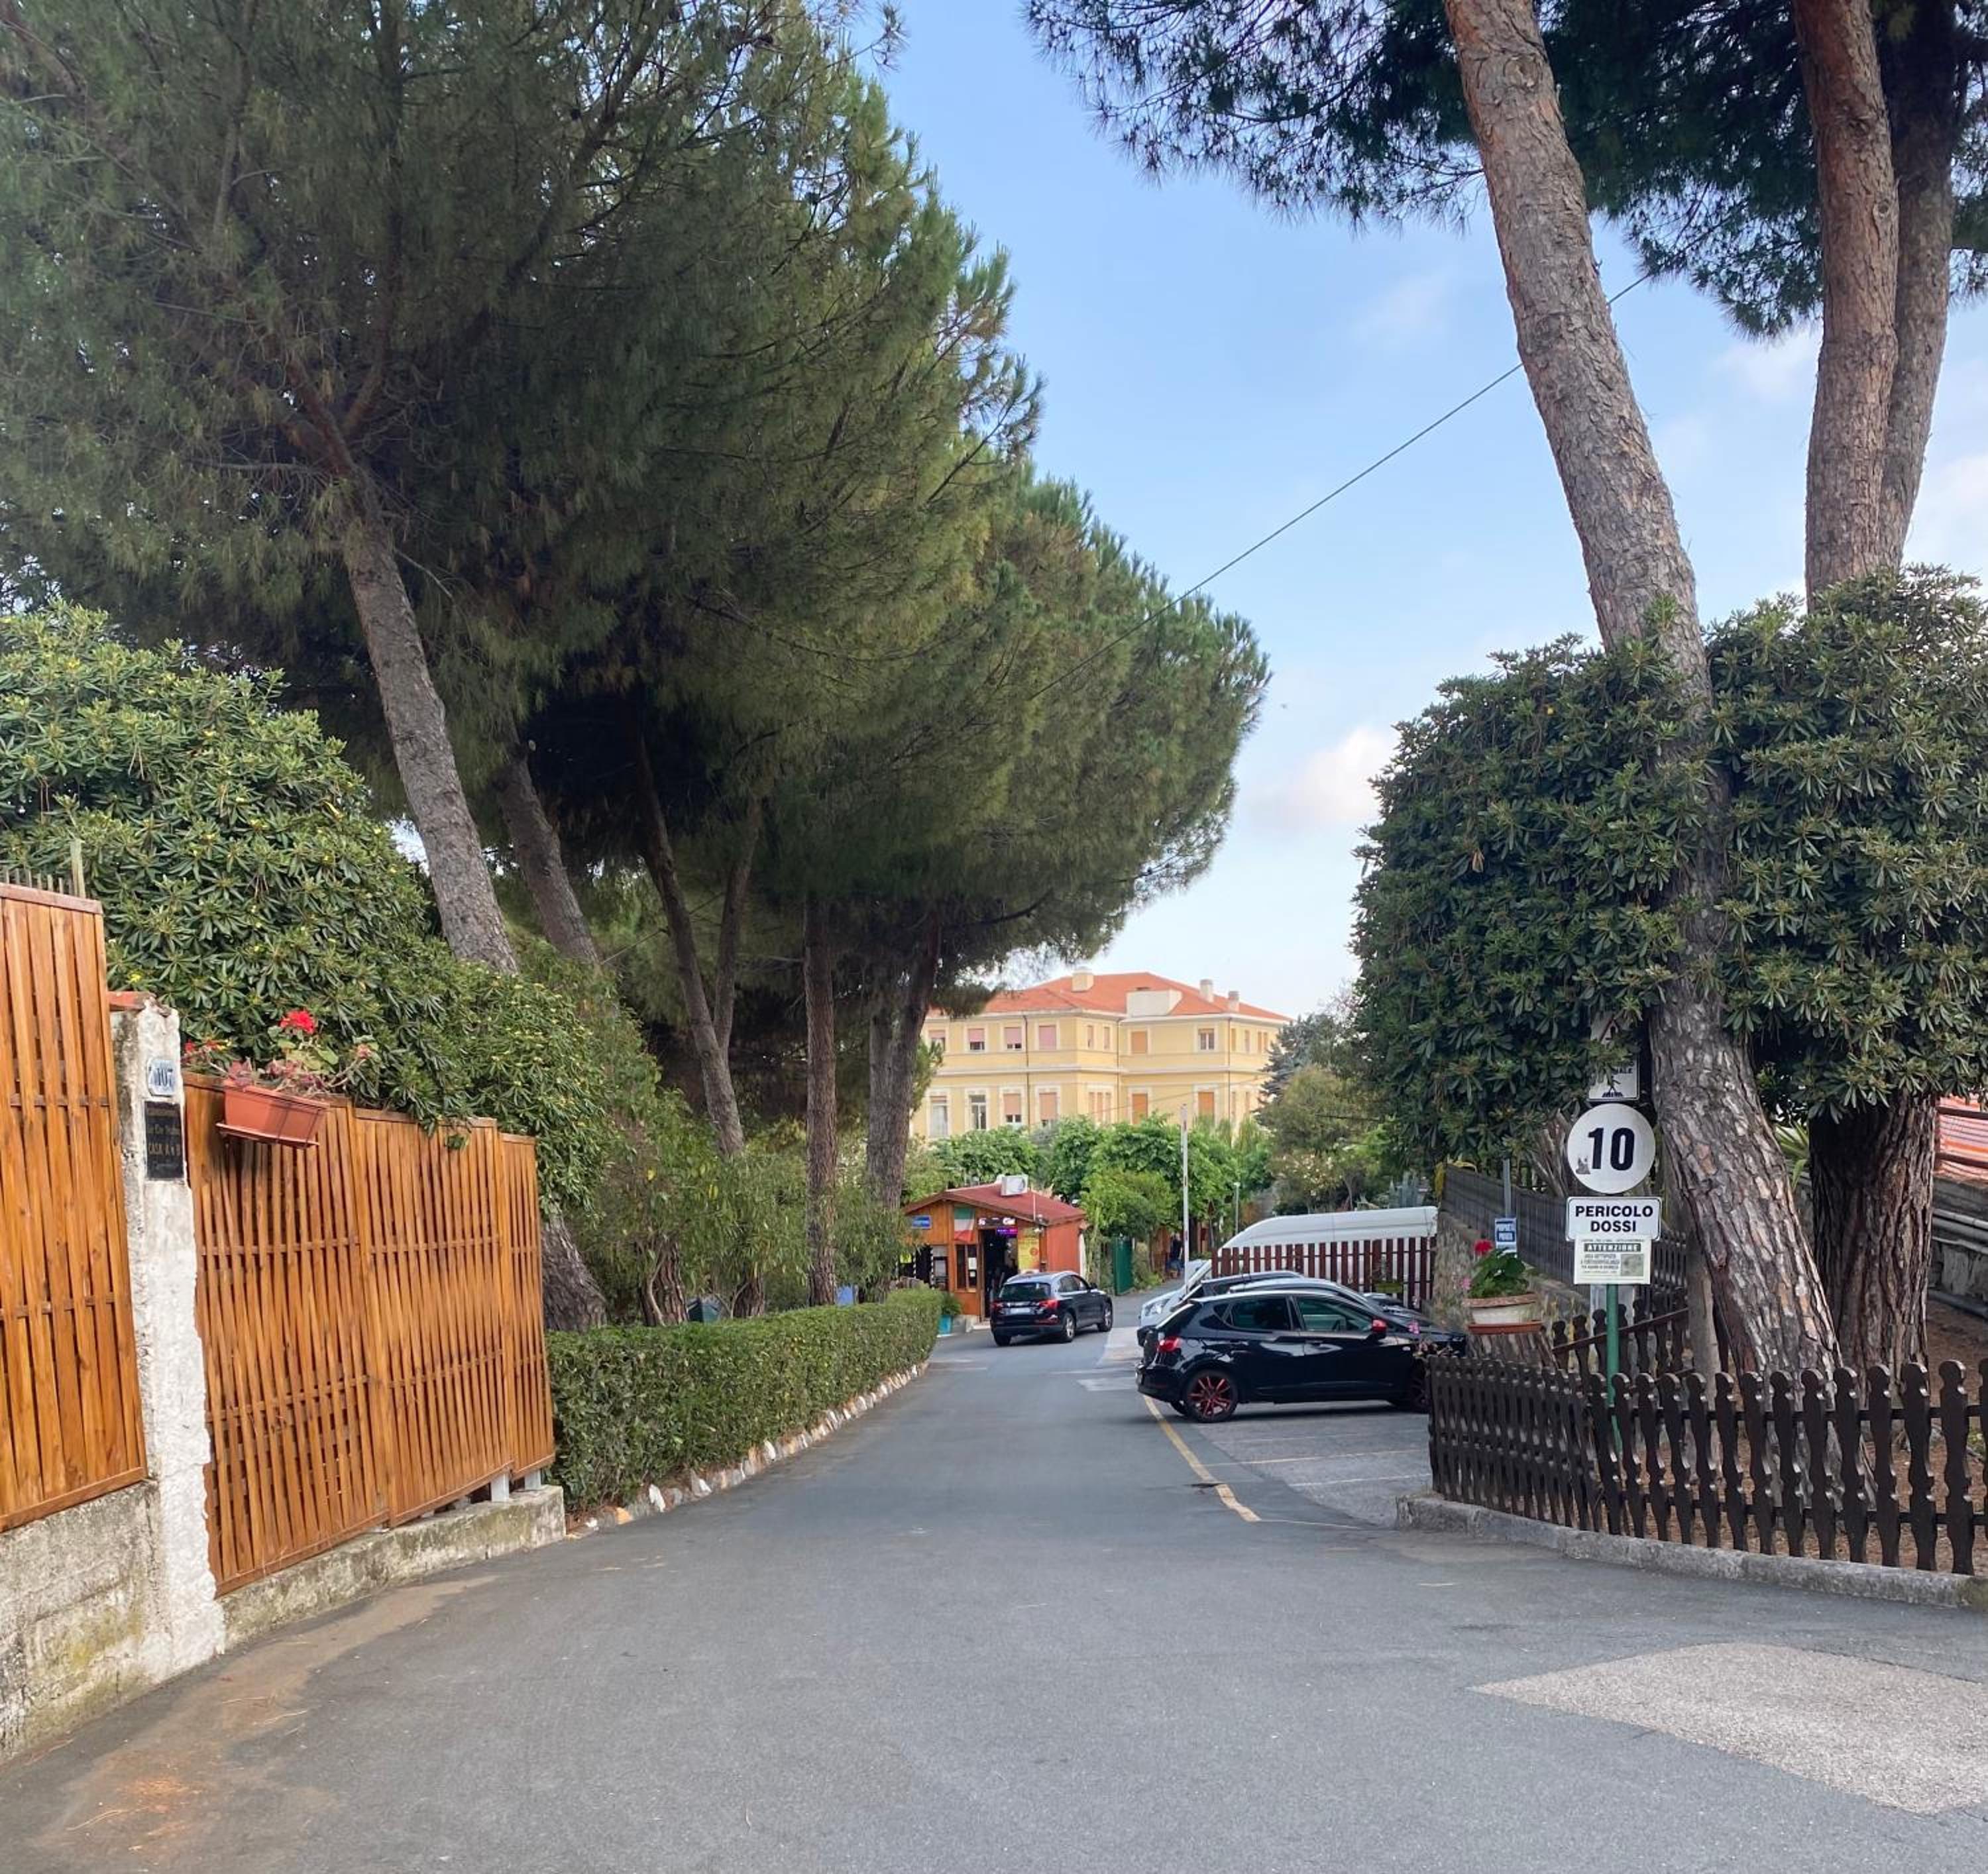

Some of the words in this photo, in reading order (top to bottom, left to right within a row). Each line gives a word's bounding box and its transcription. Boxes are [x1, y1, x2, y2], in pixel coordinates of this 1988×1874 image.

[1588, 1127, 1635, 1171] 10
[1575, 1205, 1653, 1217] PERICOLO
[1591, 1221, 1636, 1232] DOSSI
